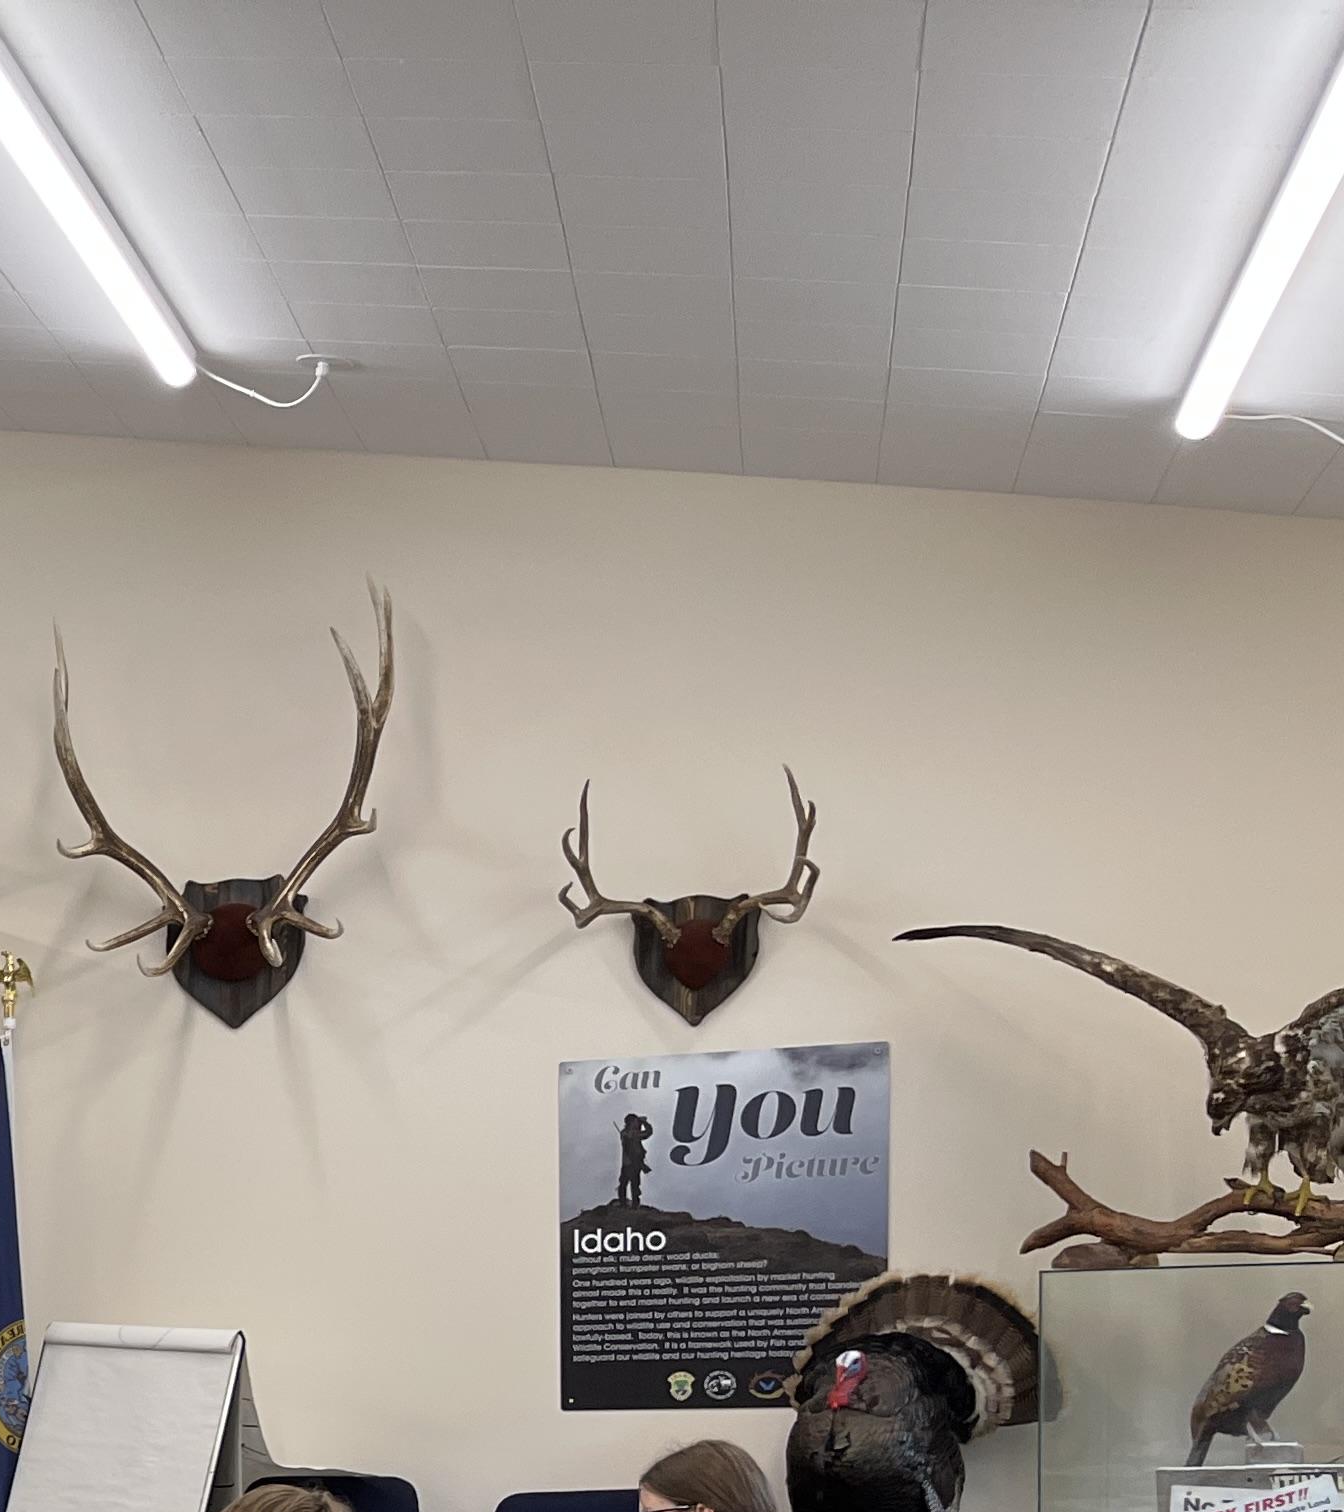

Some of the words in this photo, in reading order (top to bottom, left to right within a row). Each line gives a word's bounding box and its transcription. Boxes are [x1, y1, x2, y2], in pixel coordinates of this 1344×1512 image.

[593, 1065, 662, 1094] Can
[735, 1152, 880, 1184] Picture
[573, 1226, 666, 1254] Idaho
[691, 1286, 707, 1294] was
[709, 1285, 723, 1293] the
[724, 1284, 757, 1294] hunting
[1307, 1497, 1331, 1509] Land
